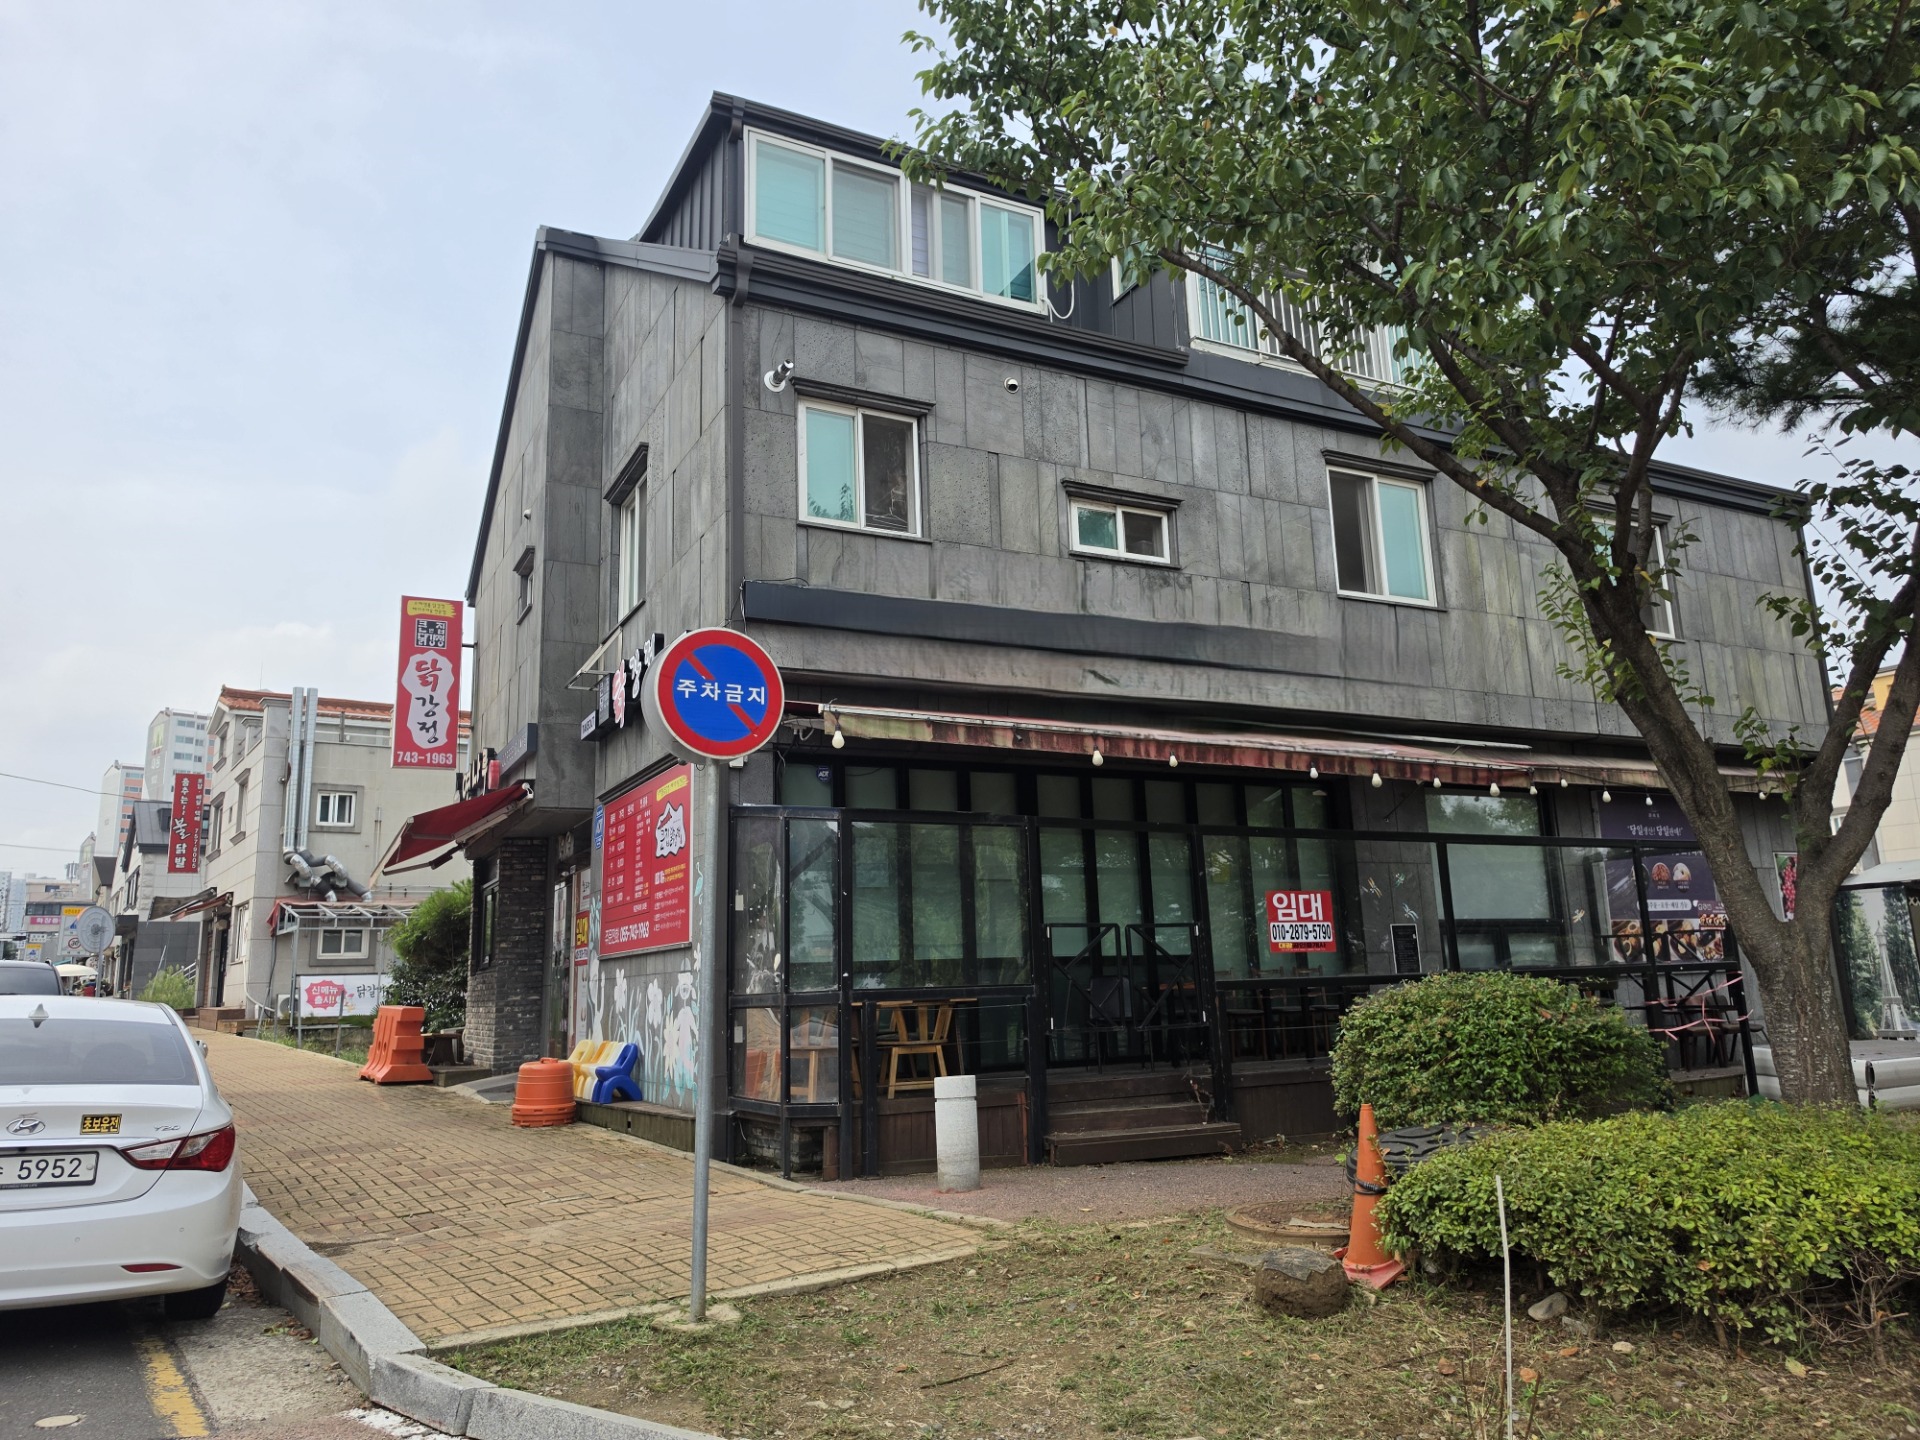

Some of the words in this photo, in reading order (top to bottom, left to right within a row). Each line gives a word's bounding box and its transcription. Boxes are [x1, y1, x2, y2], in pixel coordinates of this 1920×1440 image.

[415, 658, 442, 744] 닭강정
[677, 679, 766, 705] 주차금지
[397, 751, 453, 766] 743-1963
[1272, 892, 1324, 921] 임대
[1272, 924, 1332, 941] 010-2879-5790
[311, 985, 339, 995] 신메뉴
[82, 1116, 119, 1133] 초보운전
[17, 1157, 82, 1180] 5952
